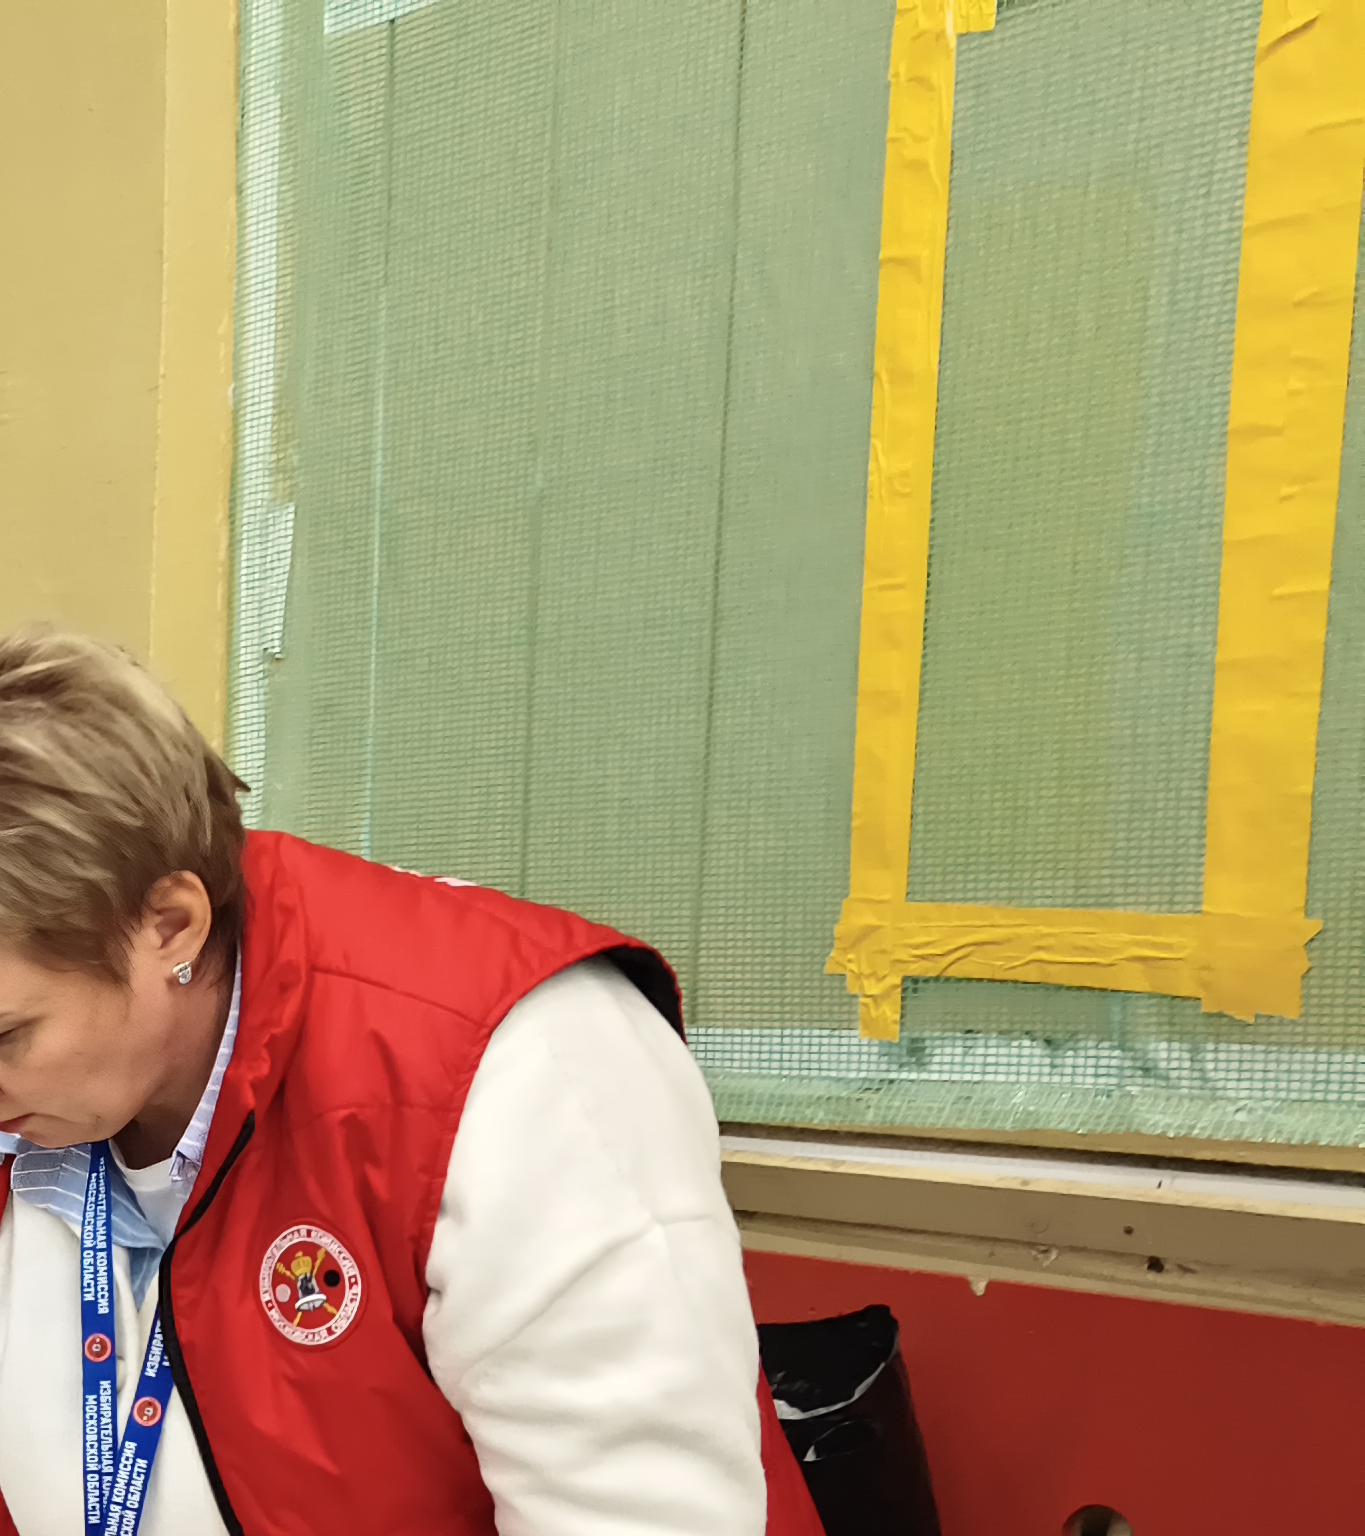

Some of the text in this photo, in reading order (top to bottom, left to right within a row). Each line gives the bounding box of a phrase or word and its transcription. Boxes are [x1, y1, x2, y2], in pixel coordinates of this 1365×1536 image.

[82, 1172, 97, 1301] МОСКОВСКОЙ ОБЛАСТИ
[96, 1252, 109, 1315] КОМИССИЯ
[85, 1395, 101, 1524] МОСКОВСКОЙ ОБЛАСТИ
[99, 1380, 114, 1473] ИЗБИРАТЕЛЬНАЯ
[111, 1440, 138, 1504] КОМИССИЯ
[126, 1457, 149, 1509] ОБЛАСТИ
